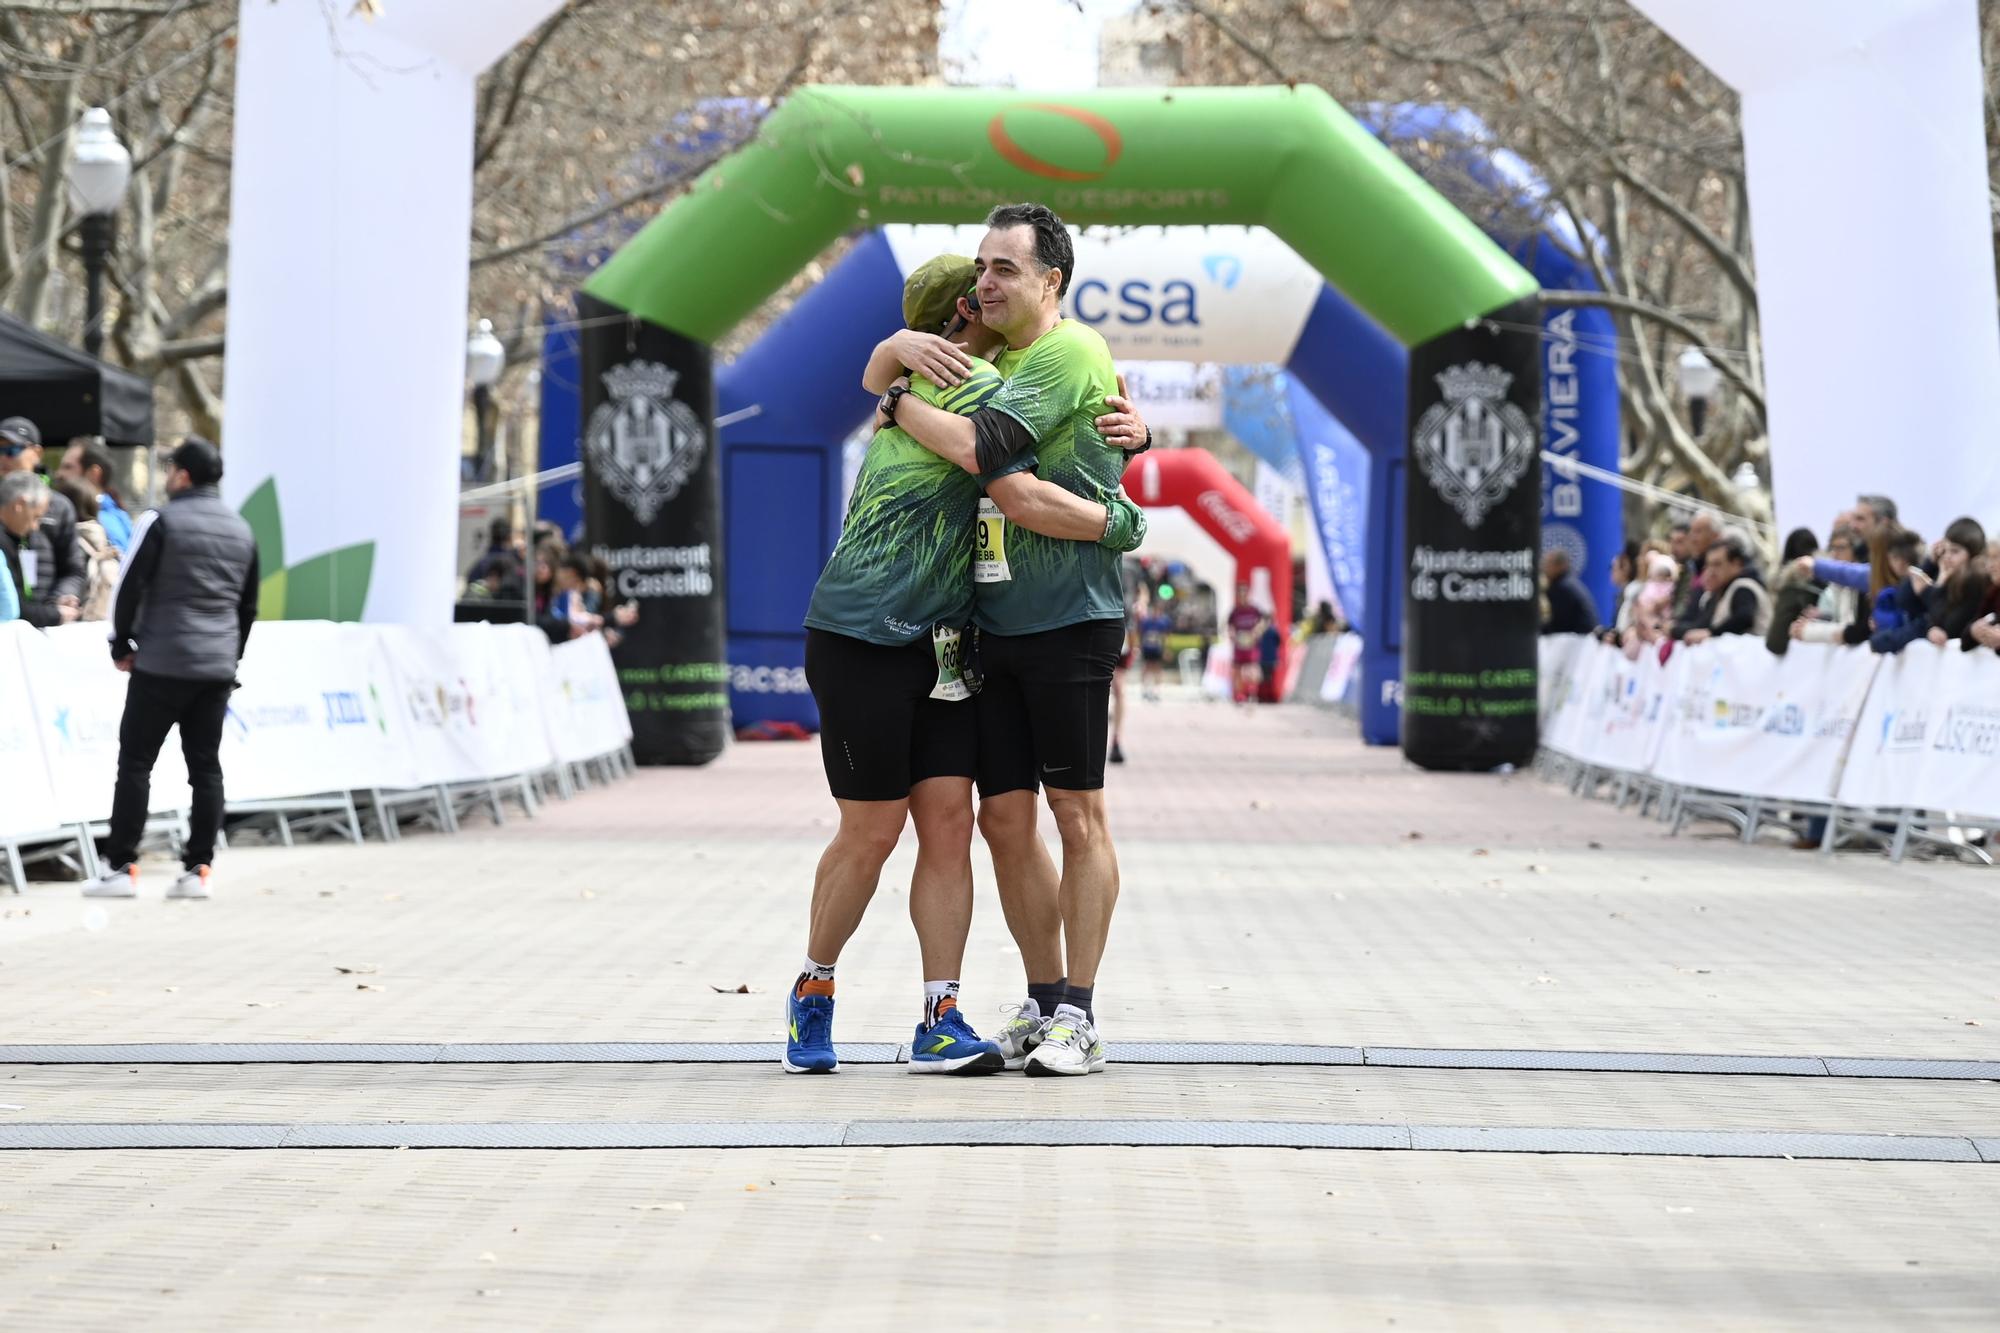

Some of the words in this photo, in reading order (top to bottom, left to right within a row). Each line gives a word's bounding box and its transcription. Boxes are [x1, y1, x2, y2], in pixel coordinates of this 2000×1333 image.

[1061, 278, 1202, 326] csa
[1547, 308, 1583, 518] BAVIERA
[592, 543, 711, 569] juntament
[1411, 545, 1533, 577] Ajuntament
[1411, 573, 1438, 600] de
